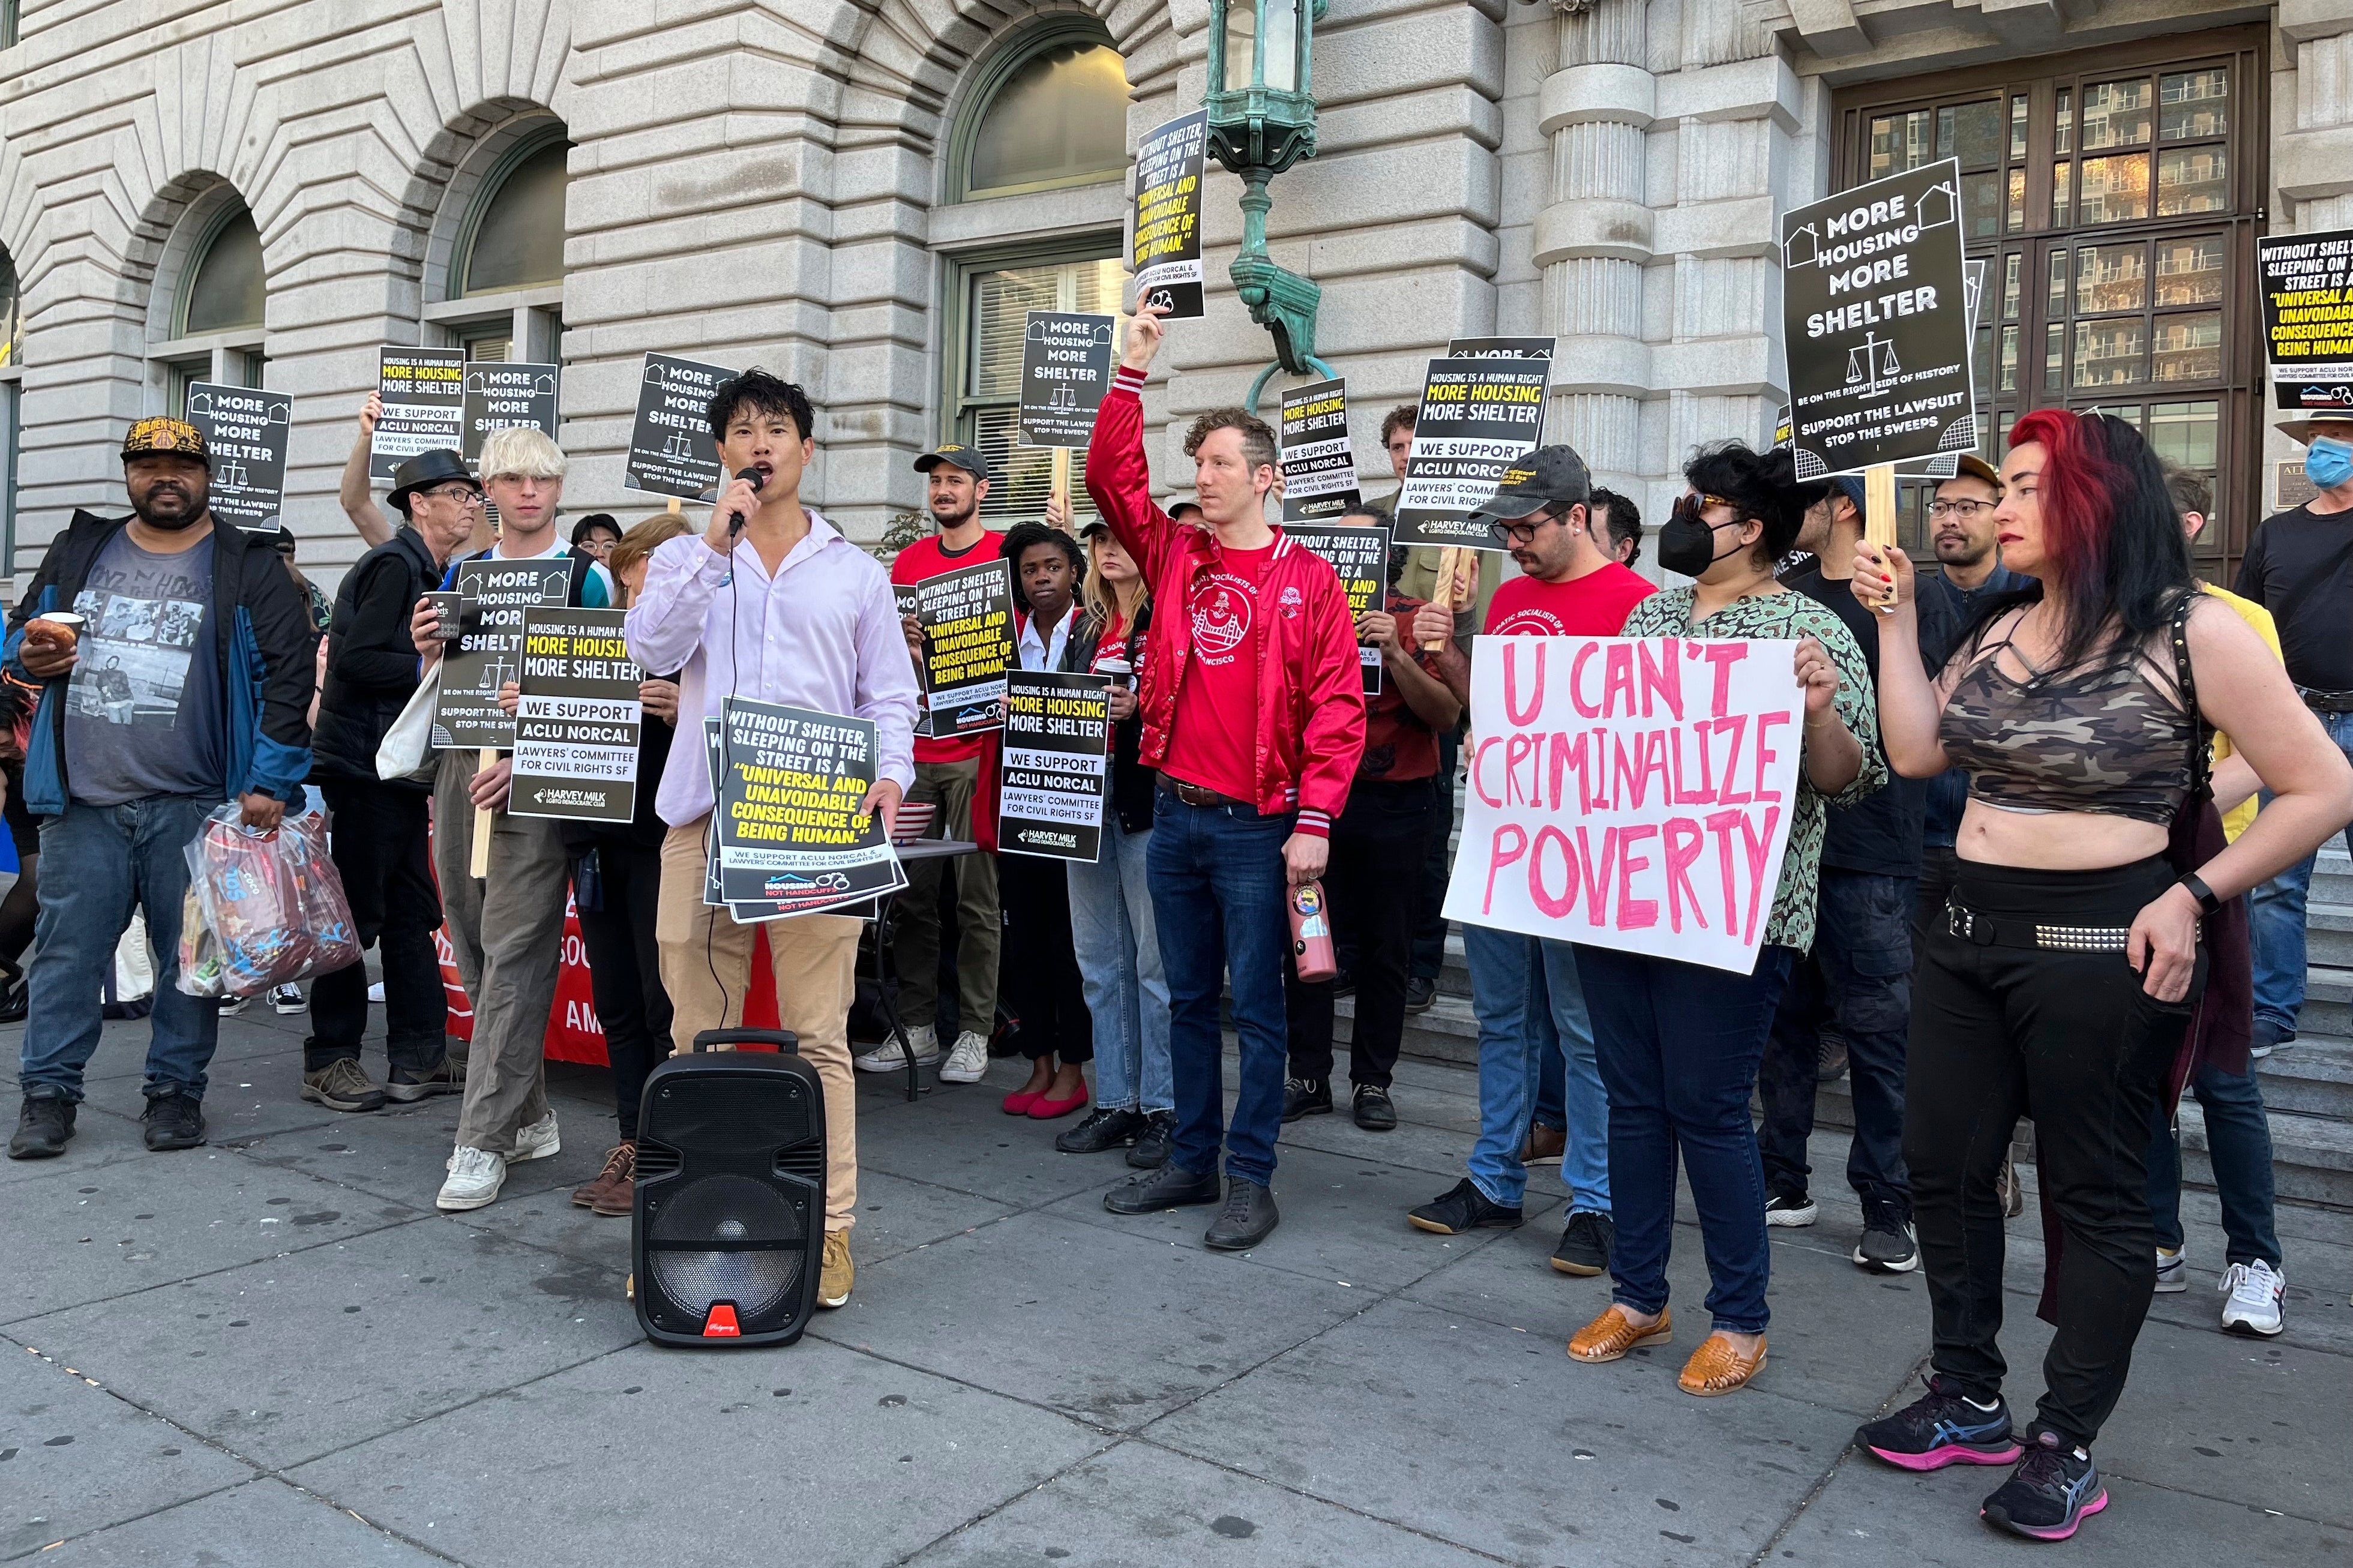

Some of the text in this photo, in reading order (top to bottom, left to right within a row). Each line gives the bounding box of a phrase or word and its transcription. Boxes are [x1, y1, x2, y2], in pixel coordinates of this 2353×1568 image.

[1138, 122, 1202, 161] WITHOUT SHELTER,
[1140, 139, 1200, 177] SLEEPING ON THE
[1827, 194, 1907, 239] MORE
[1818, 224, 1919, 268] HOUSING
[2261, 243, 2317, 262] WITHOUT
[1829, 254, 1909, 295] MORE
[2267, 256, 2346, 277] SLEEPING ON
[2285, 272, 2343, 290] STREET IS
[1806, 285, 1938, 338] SHELTER
[1050, 322, 1090, 334] MORE
[1044, 337, 1093, 347] HOUSING
[2277, 341, 2309, 356] BEING
[1048, 350, 1087, 362] MORE
[383, 366, 461, 380] MORE HOUSING
[489, 373, 530, 385] MORE
[669, 367, 712, 385] MORE
[1035, 367, 1096, 381] SHELTER
[382, 380, 461, 395] MORE SHELTER
[483, 388, 535, 398] HOUSING
[1427, 385, 1541, 403] MORE HOUSING
[1798, 364, 1961, 406] BE ON THE RIGHT SIDE OF HISTORY
[218, 395, 263, 412] MORE
[383, 407, 456, 419] WE SUPPORT
[488, 401, 529, 413] MORE
[665, 395, 708, 413] MORE
[1284, 397, 1344, 421] MORE HOUSING
[210, 410, 268, 426] HOUSING
[1423, 404, 1537, 423] MORE SHELTER
[1801, 413, 1861, 436] SUPPORT
[1863, 406, 1892, 423] THE
[1894, 392, 1964, 417] LAWSUIT
[136, 419, 194, 442] GOLDEN STATE
[215, 424, 261, 441] MORE
[379, 421, 455, 433] ACLU NORCAL
[1283, 412, 1345, 436] MORE SHELTER
[1825, 416, 1938, 448] STOP THE SWEEPS
[1285, 442, 1344, 460] WE SUPPORT
[1420, 443, 1525, 458] WE SUPPORT
[632, 461, 717, 482] SUPPORT THE LAWSUIT
[1285, 456, 1348, 474] ACLU NORCAL
[224, 498, 239, 506] THE
[488, 572, 538, 587] MORE
[919, 569, 1004, 601] WITHOUT SHELTER,
[478, 592, 542, 605] HOUSING
[922, 591, 966, 613] SLEEPING
[969, 589, 983, 600] ON
[985, 583, 1004, 596] THE
[936, 601, 991, 623] STREET IS A
[1517, 609, 1563, 629] SOCIALISTS OF
[529, 623, 616, 636] HOUSING IS A HUMAN
[527, 636, 568, 655] MORE
[934, 628, 1001, 652] UNAVOIDABLE
[930, 642, 1012, 668] CONSEQUENCE OF
[1194, 647, 1234, 665] FRANCISCO
[525, 658, 640, 681] MORE SHELTER
[1503, 638, 1748, 727] U CAN'T
[441, 708, 505, 717] SUPPORT THE
[526, 701, 633, 720] WE SUPPORT
[1011, 697, 1044, 713] MORE
[1047, 700, 1105, 718] HOUSING
[522, 723, 630, 742] ACLU NORCAL
[727, 710, 868, 746] WITHOUT SHELTER,
[1009, 715, 1103, 737] MORE SHELTER
[518, 746, 634, 762] LAWYERS' COMMITTEE
[733, 729, 867, 762] SLEEPING ON THE
[521, 760, 628, 775] FOR CIVIL RIGHTS SF
[756, 751, 846, 775] STREET IS A
[1011, 753, 1097, 772] WE SUPPORT
[1473, 710, 1790, 816] CRIMINALIZE
[833, 778, 867, 795] AND
[1008, 773, 1096, 792] ACLU NORCAL
[547, 789, 606, 802] HARVEY MILK
[745, 785, 858, 812] UNAVOIDABLE
[732, 802, 871, 829] CONSEQUENCE OF
[1008, 804, 1095, 820] FOR CIVIL RIGHTS SF
[737, 822, 787, 841] BEING
[1029, 829, 1076, 842] HARVEY MILK
[828, 852, 868, 860] NORCAL
[1482, 806, 1781, 946] POVERTY
